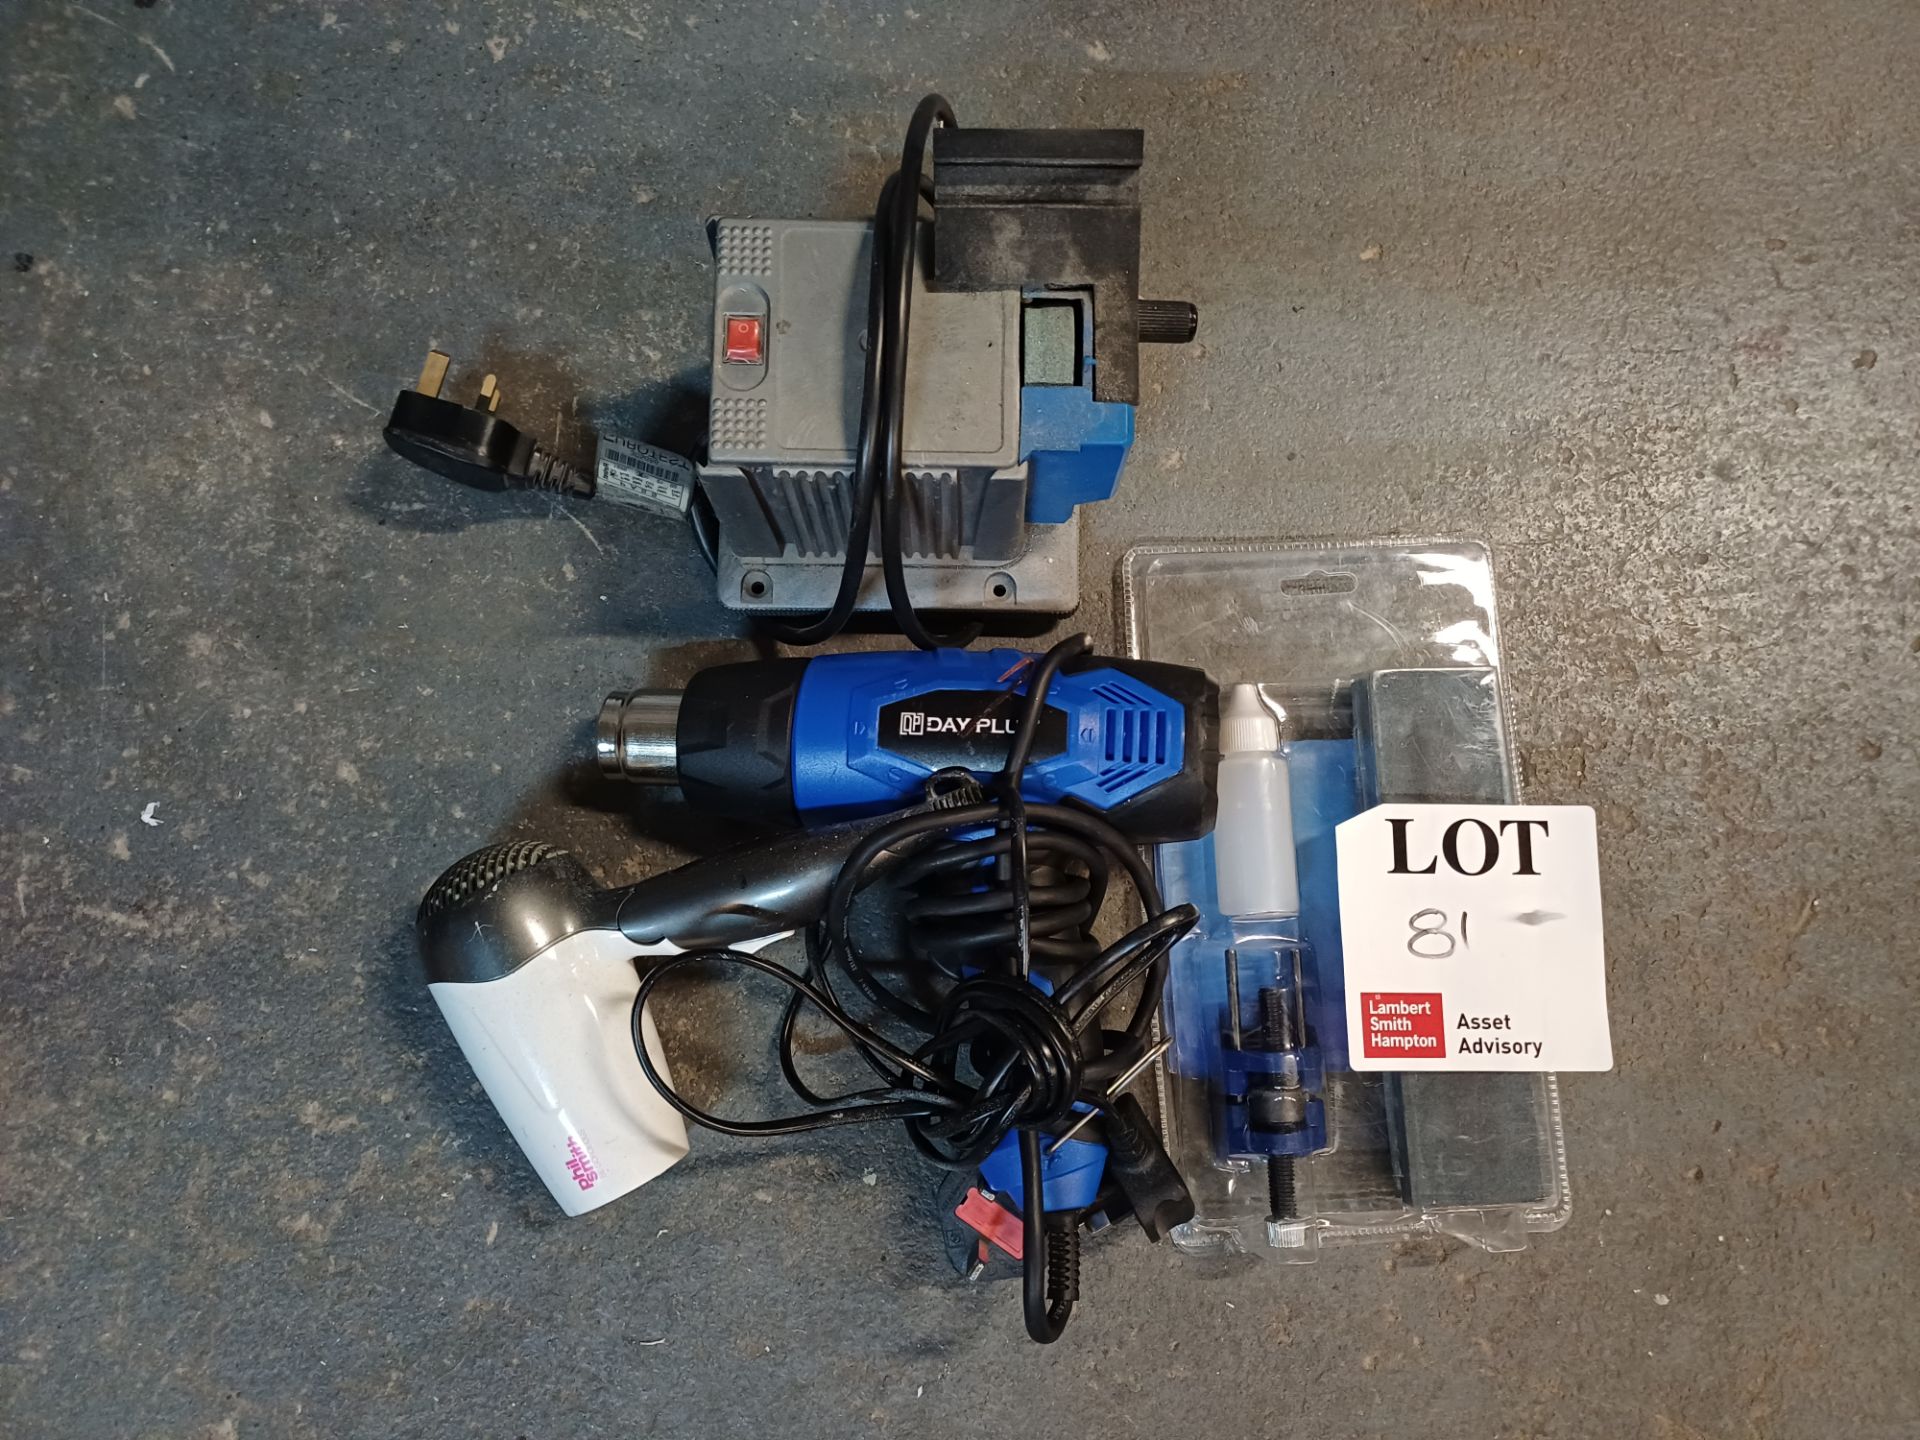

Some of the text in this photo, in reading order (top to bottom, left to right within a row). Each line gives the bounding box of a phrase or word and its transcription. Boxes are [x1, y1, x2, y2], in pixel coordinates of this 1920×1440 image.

[926, 717, 971, 732] DAY
[975, 718, 1039, 734] PLU
[1385, 818, 1549, 876] LOT
[1407, 908, 1470, 959] 81
[1369, 1000, 1431, 1014] Lambert
[1370, 1016, 1412, 1031] Smith
[1456, 1013, 1511, 1030] Asset
[1371, 1033, 1437, 1050] Hampton
[1458, 1038, 1543, 1058] Advisory
